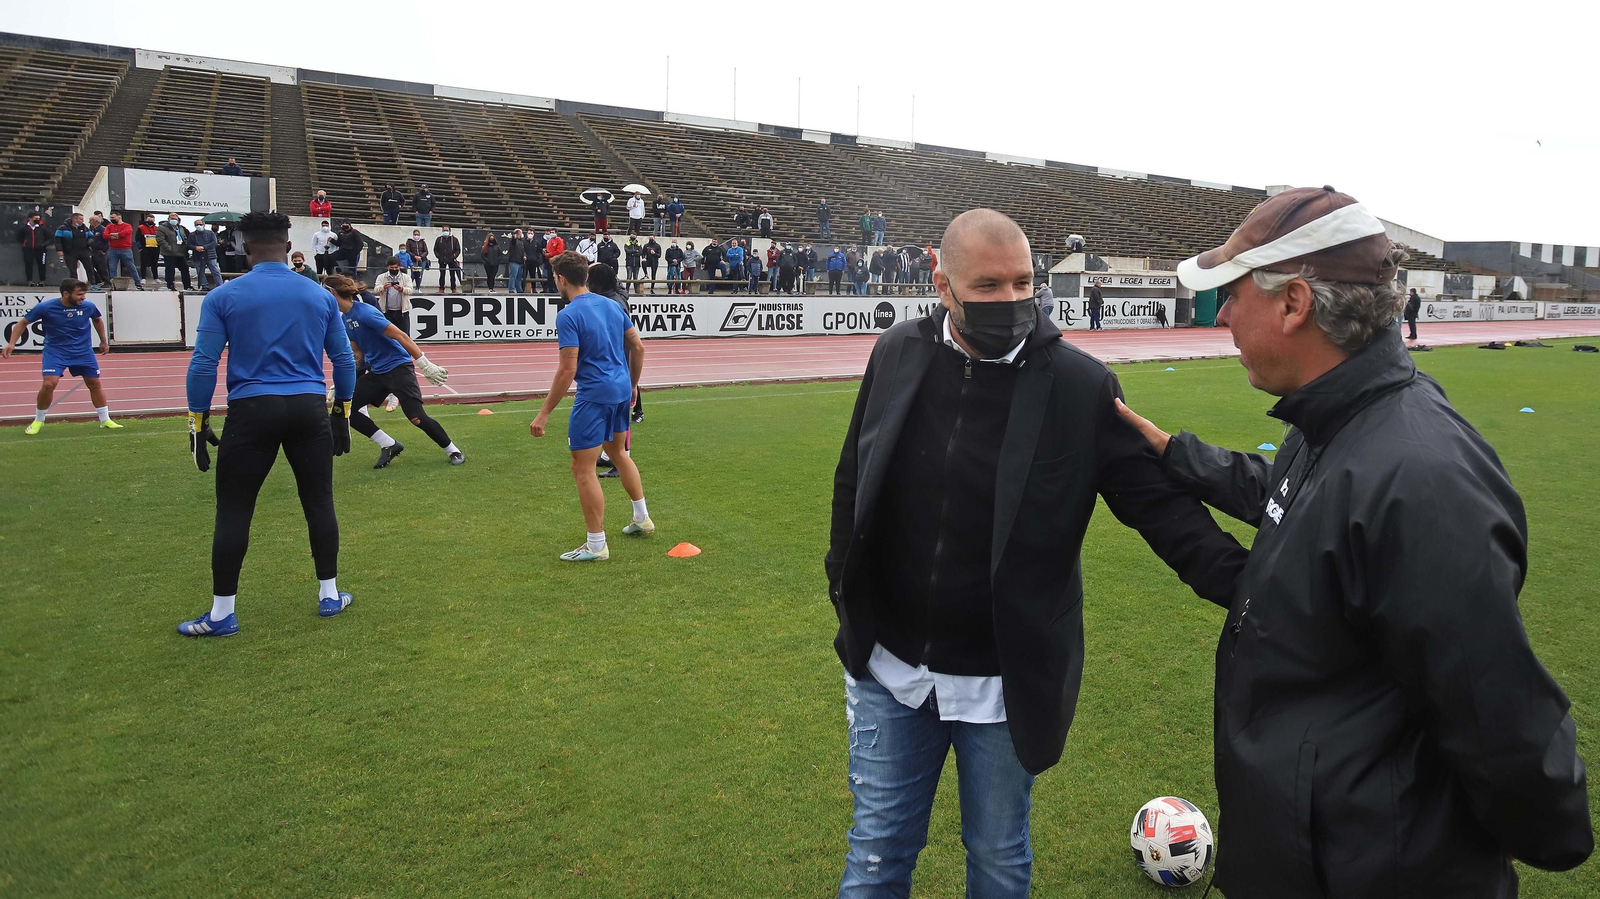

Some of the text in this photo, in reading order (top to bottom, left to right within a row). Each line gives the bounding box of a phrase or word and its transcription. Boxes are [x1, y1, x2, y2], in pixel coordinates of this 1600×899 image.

[161, 198, 192, 206] BALONA
[1088, 276, 1113, 284] LEGEA
[0, 295, 26, 306] ES
[629, 303, 695, 314] PINTURAS
[758, 303, 804, 311] INDUSTRIAS
[1082, 301, 1117, 321] Rjas
[632, 314, 697, 332] MATA
[757, 313, 804, 331] LACSE
[823, 309, 893, 330] GPON linea
[0, 321, 45, 347] OS
[445, 330, 470, 339] THE
[474, 329, 521, 339] POWER
[525, 328, 543, 338] OF
